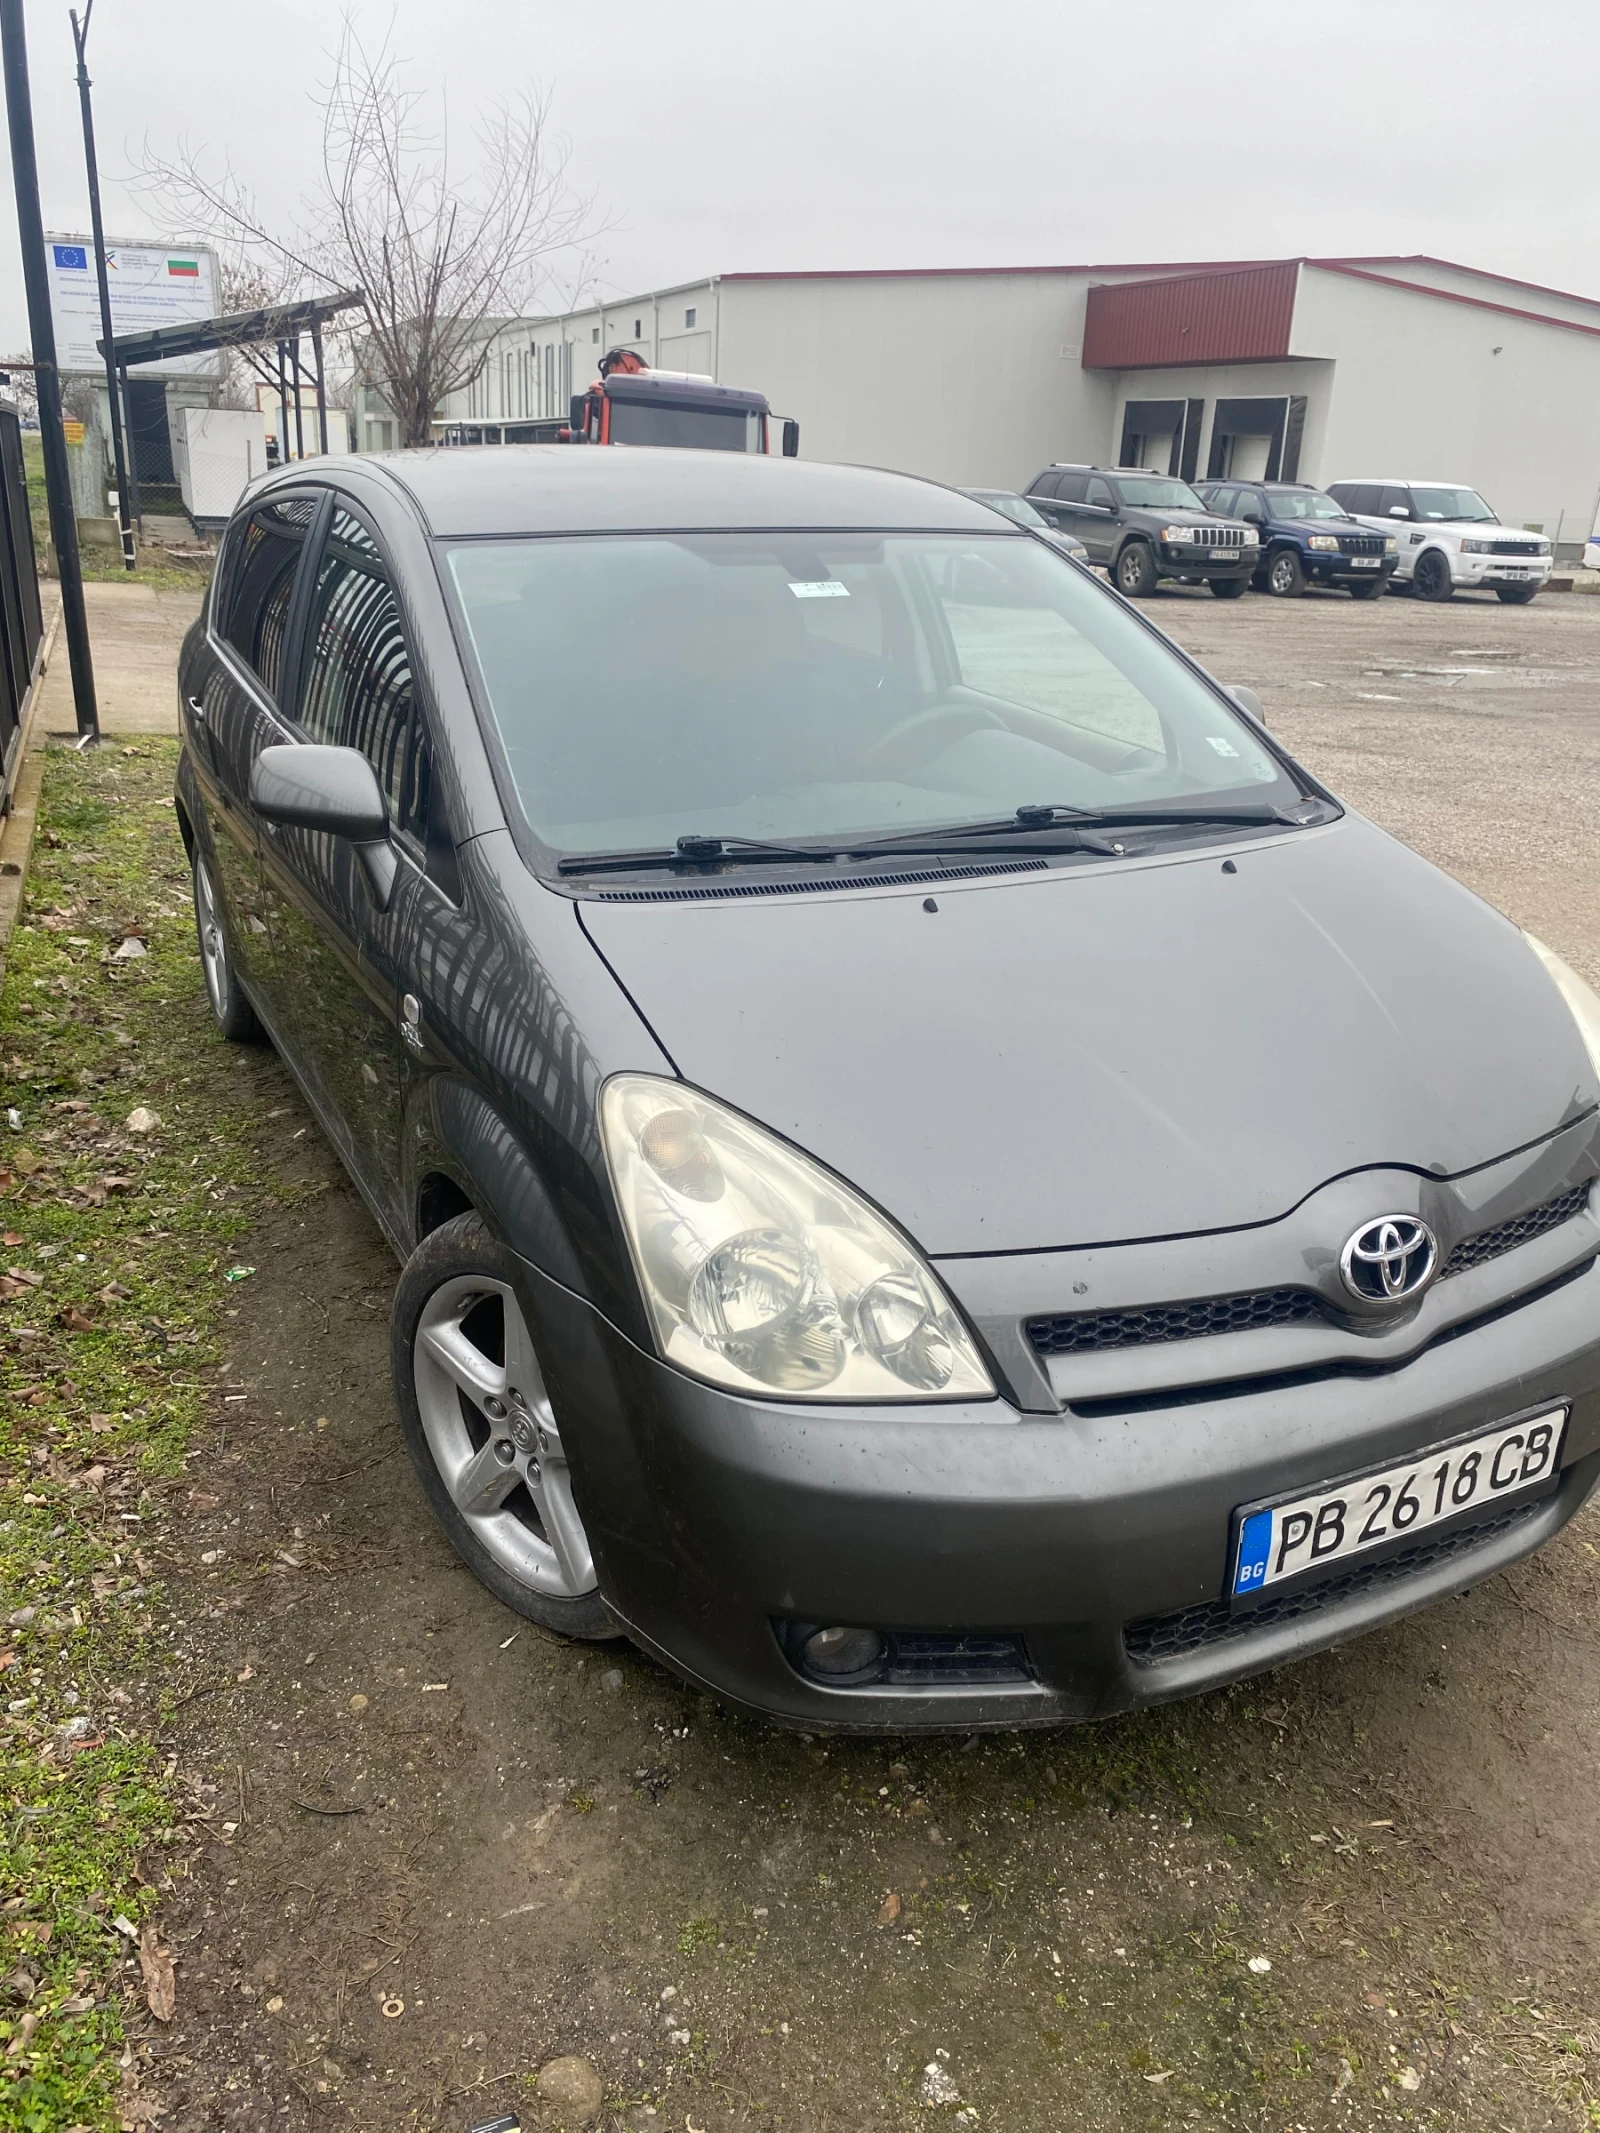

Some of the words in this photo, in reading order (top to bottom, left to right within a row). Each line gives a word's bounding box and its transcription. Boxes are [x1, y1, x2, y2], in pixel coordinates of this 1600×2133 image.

[1274, 1499, 1347, 1575] PB
[1357, 1451, 1482, 1544] 2618
[1490, 1423, 1553, 1490] CB
[1239, 1560, 1264, 1583] BG
